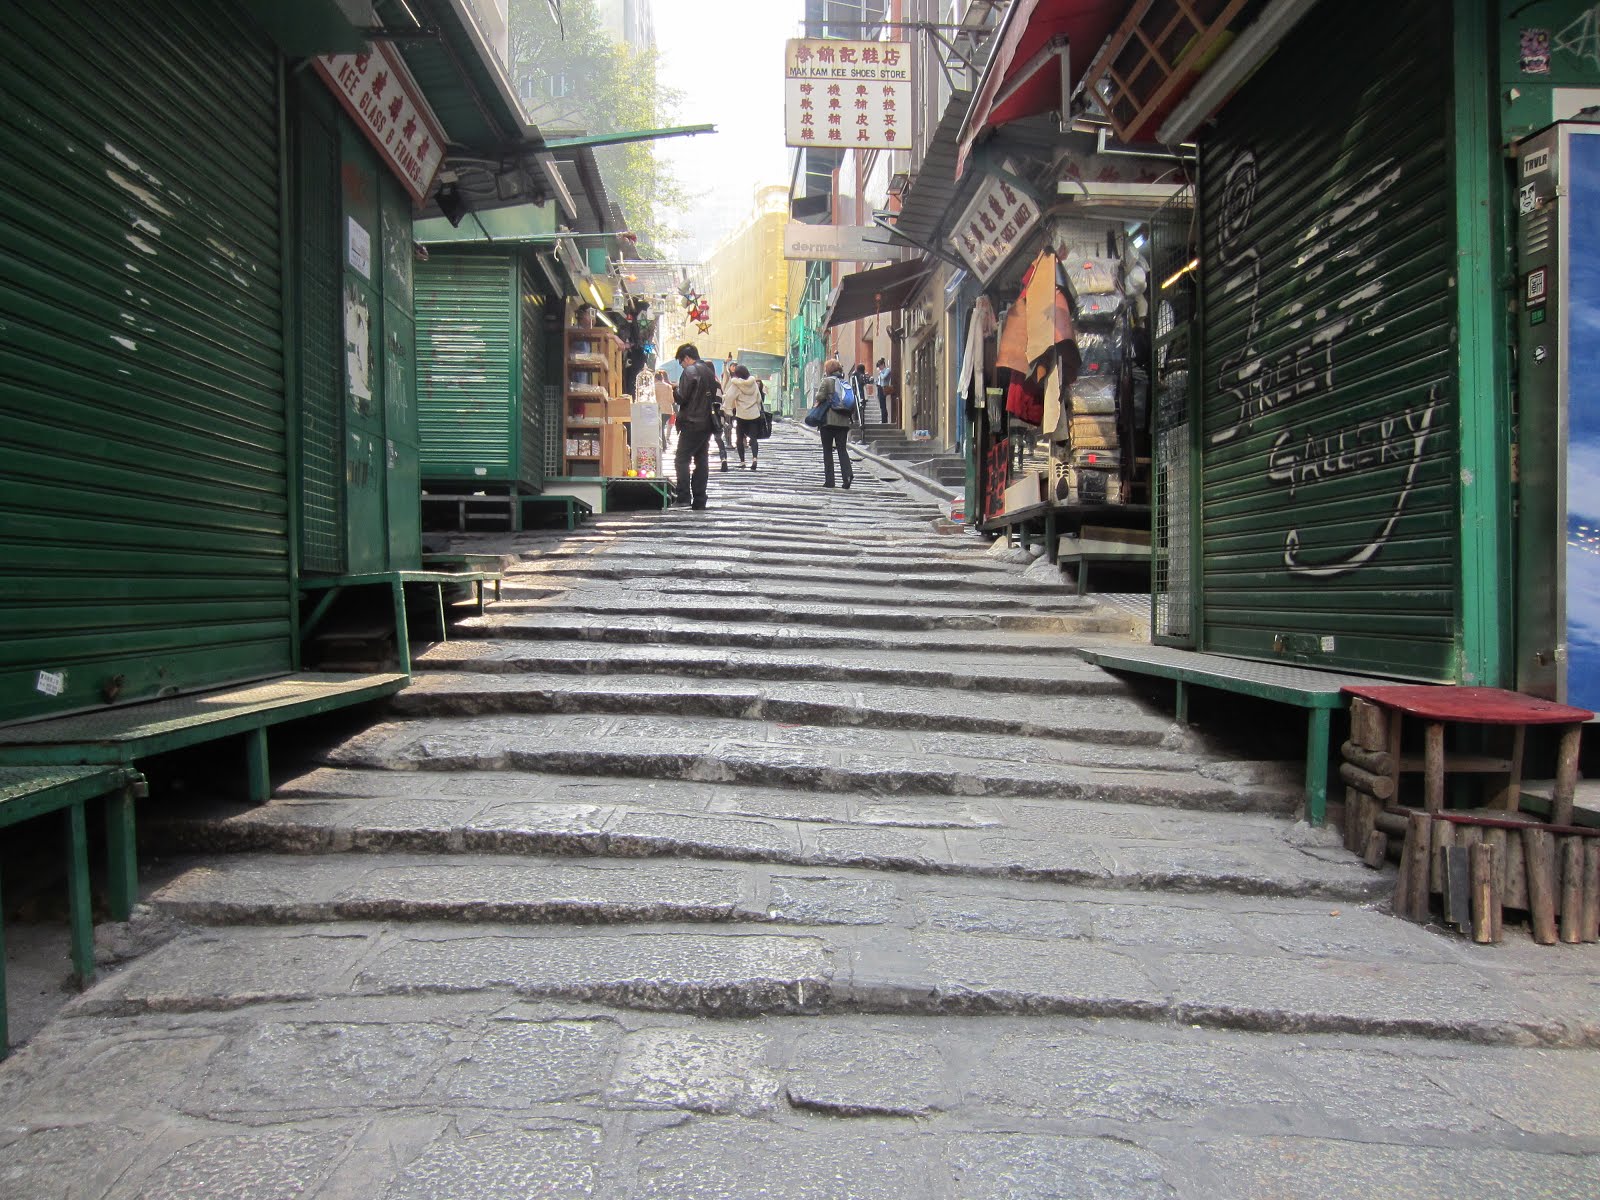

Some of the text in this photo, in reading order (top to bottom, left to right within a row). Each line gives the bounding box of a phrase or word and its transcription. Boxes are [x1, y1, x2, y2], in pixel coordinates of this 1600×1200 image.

[790, 67, 906, 79] MAK KAM KEE SHOES STORE
[795, 45, 900, 66] 麥錦記鞋店
[338, 62, 360, 96] KEE
[359, 91, 386, 132] GLASS
[394, 139, 421, 181] FRAMES
[1524, 153, 1548, 172] TRVLR
[1211, 325, 1343, 443] STREET
[1268, 384, 1437, 498] GALLERY
